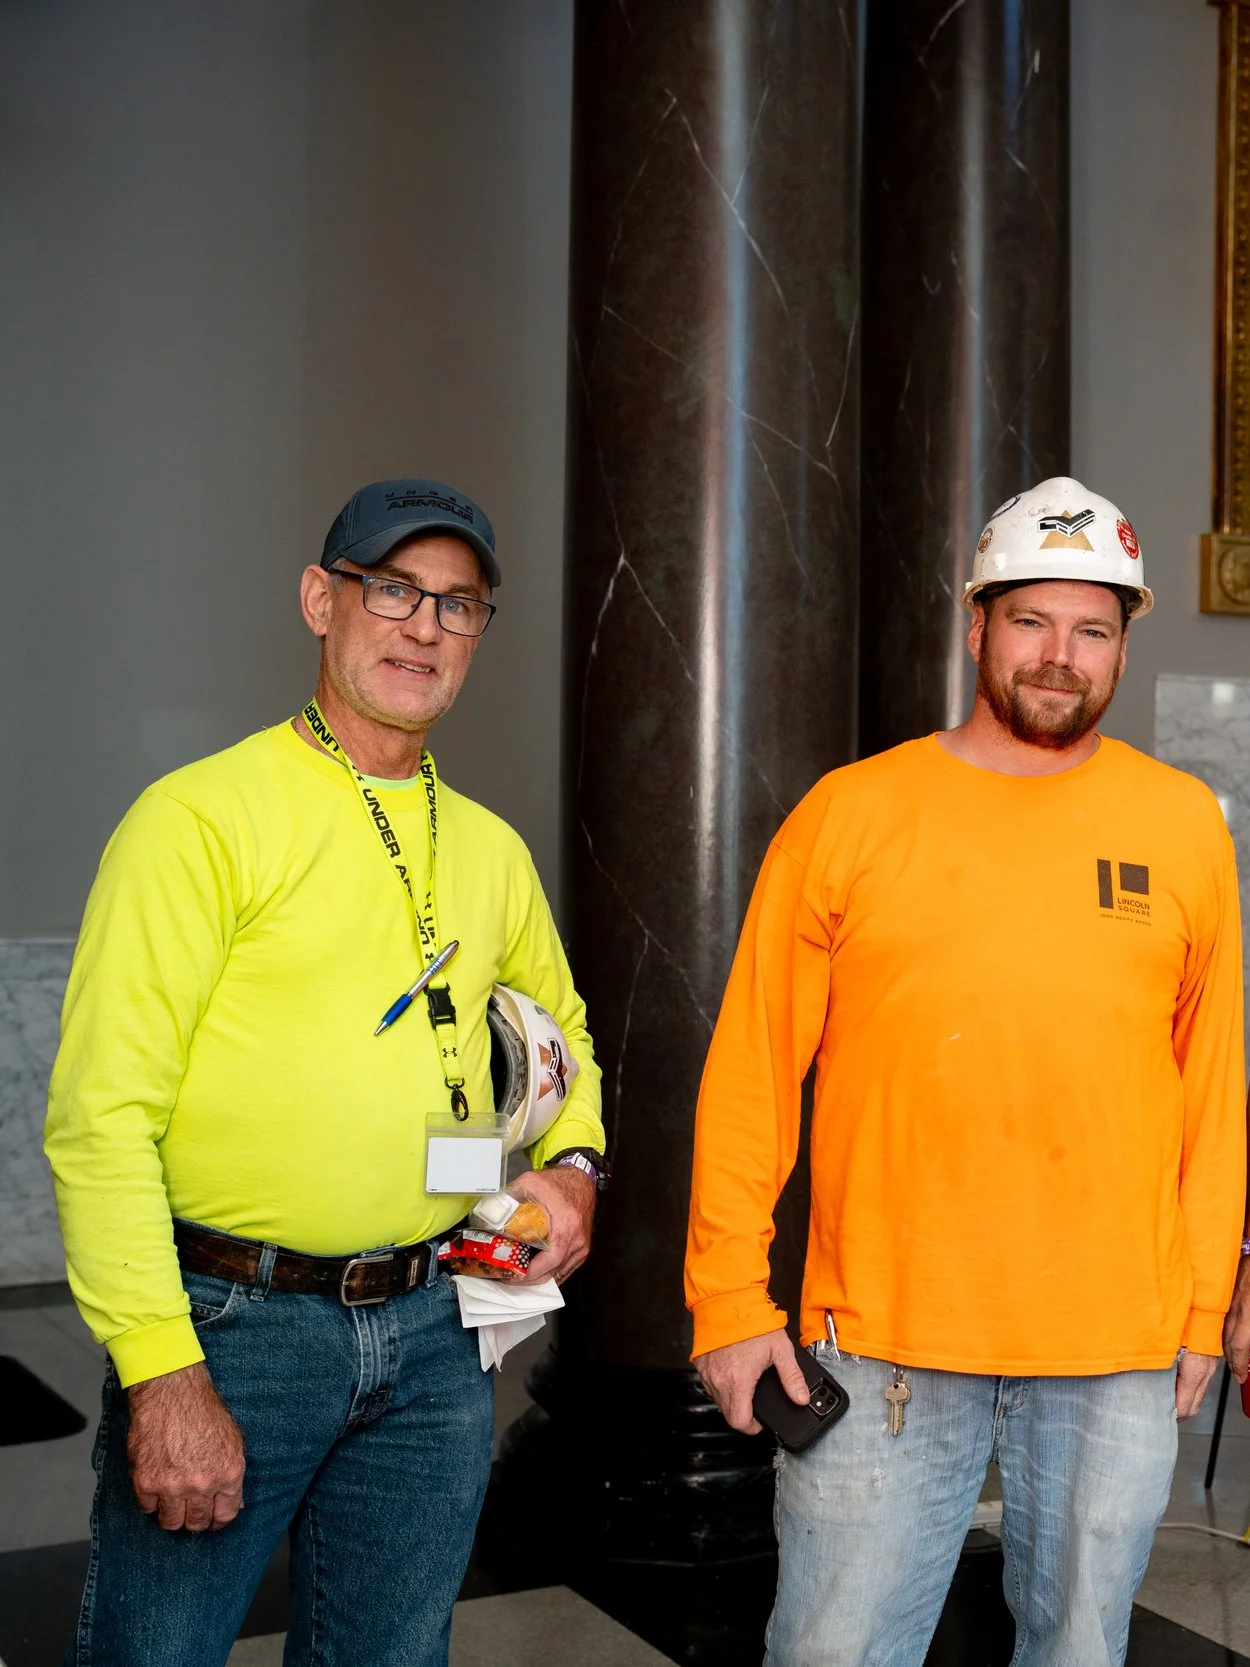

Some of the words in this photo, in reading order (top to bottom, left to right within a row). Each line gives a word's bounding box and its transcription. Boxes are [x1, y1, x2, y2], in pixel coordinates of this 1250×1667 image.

[387, 499, 474, 525] ARMOUR
[303, 702, 340, 752] UNDER
[362, 788, 402, 859] UNDER
[1117, 897, 1150, 911] LINCOLN
[1118, 906, 1151, 918] SQUARE
